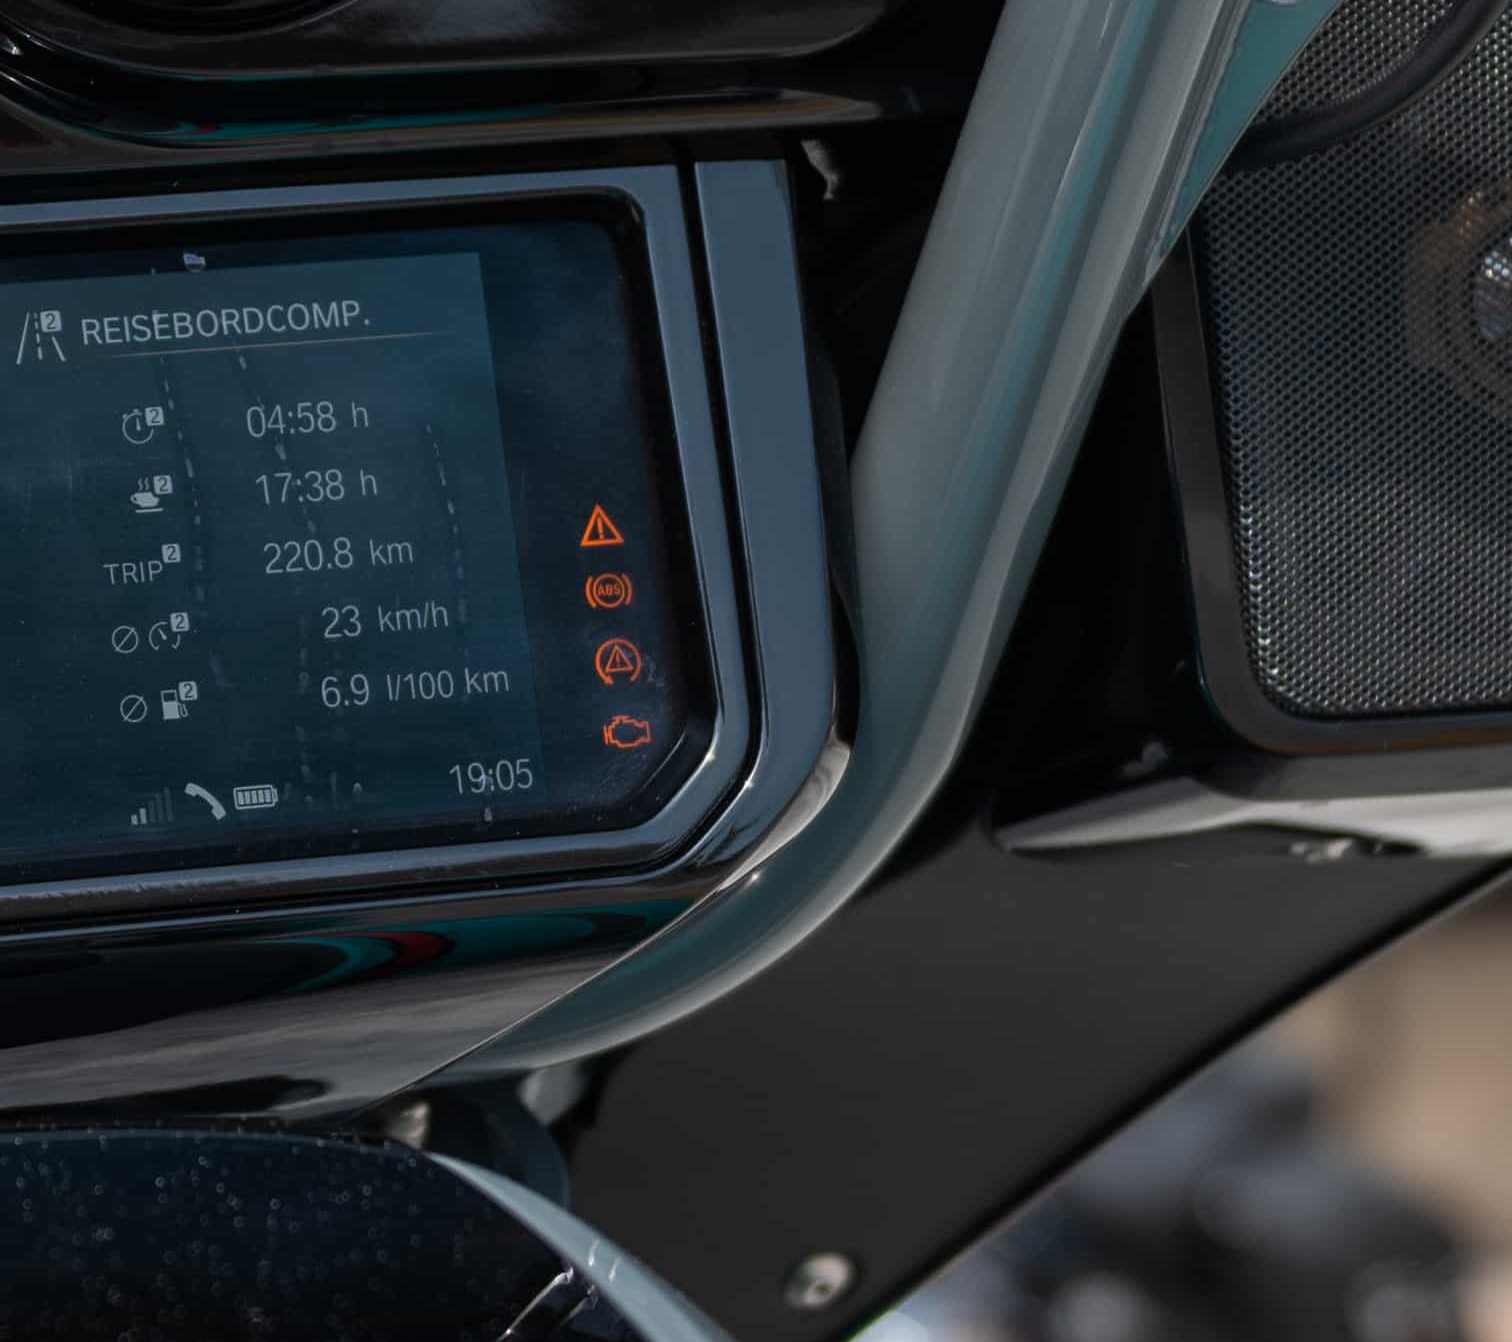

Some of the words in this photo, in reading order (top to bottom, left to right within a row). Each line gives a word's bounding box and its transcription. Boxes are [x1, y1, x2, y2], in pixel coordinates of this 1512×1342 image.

[80, 298, 371, 347] REISEBORDCOMP.
[245, 401, 337, 438] 04:58
[352, 402, 370, 429] h
[255, 470, 346, 506] 17:38
[361, 470, 379, 496] h
[103, 559, 164, 587] TRIP
[263, 538, 355, 575] 220.8
[369, 540, 415, 567] km
[321, 606, 362, 640] 23
[378, 600, 449, 633] km/h
[320, 673, 371, 709] 6.9
[464, 667, 510, 695] km
[448, 758, 535, 796] 19:05
